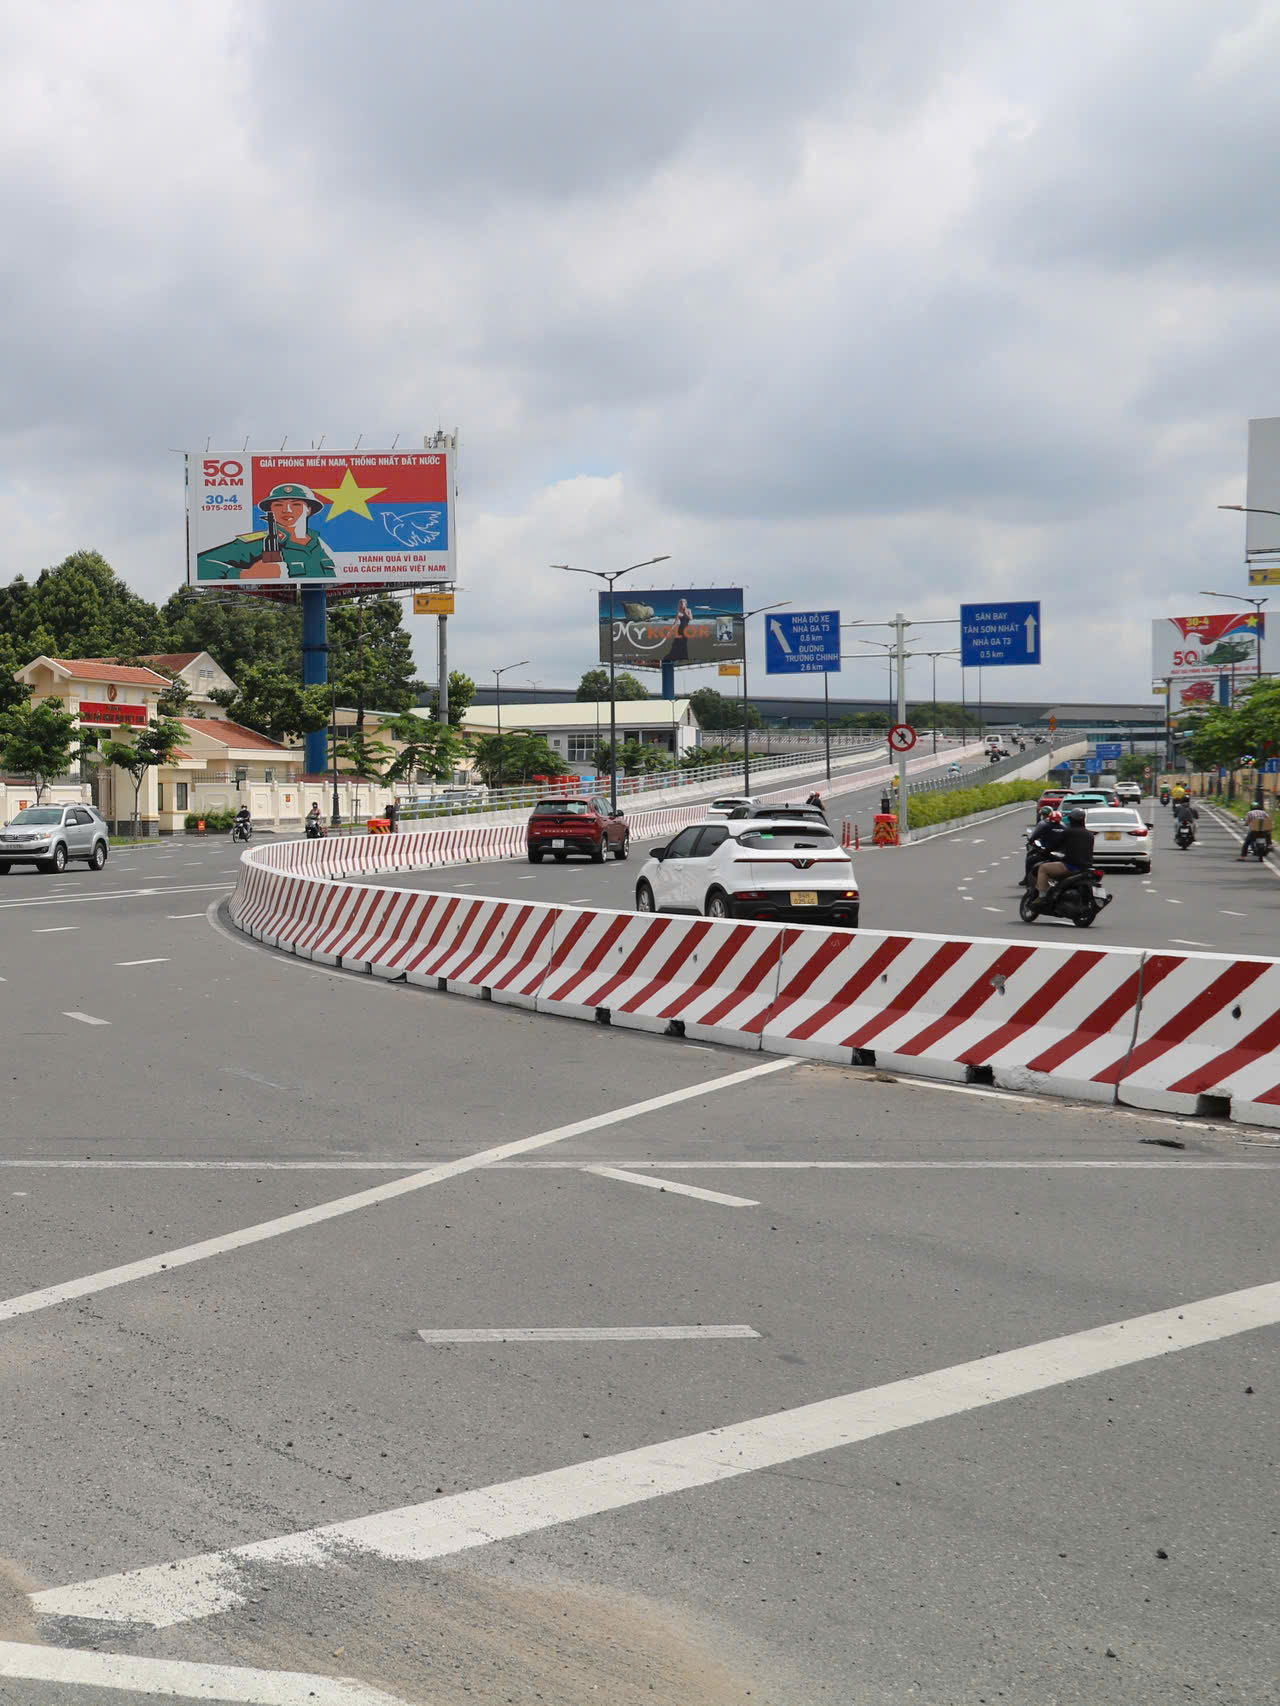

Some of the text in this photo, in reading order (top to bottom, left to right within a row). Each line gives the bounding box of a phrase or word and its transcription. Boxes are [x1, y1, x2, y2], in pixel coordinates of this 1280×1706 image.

[260, 454, 440, 468] GIẢI PHÓNG MIỀN NAM, THỐNG NHẤT ĐẤT NƯỚC
[203, 460, 243, 478] 50
[205, 477, 244, 486] NĂM
[206, 494, 238, 504] 30-4
[358, 554, 384, 563] THÀNH
[386, 552, 401, 563] QUẢ
[413, 554, 426, 563] ĐẠI
[343, 563, 446, 574] CỦA CÁCH MẠNG VIỆT NAM
[792, 614, 807, 624] NHÀ
[821, 615, 831, 623] XE
[993, 612, 1008, 620] BAY
[792, 623, 830, 633] NHÀ GA T3
[812, 634, 823, 642] km
[972, 637, 1012, 646] NHÀ GA T3
[816, 653, 838, 661] CHINH
[1173, 650, 1198, 666] 50
[812, 663, 823, 671] km
